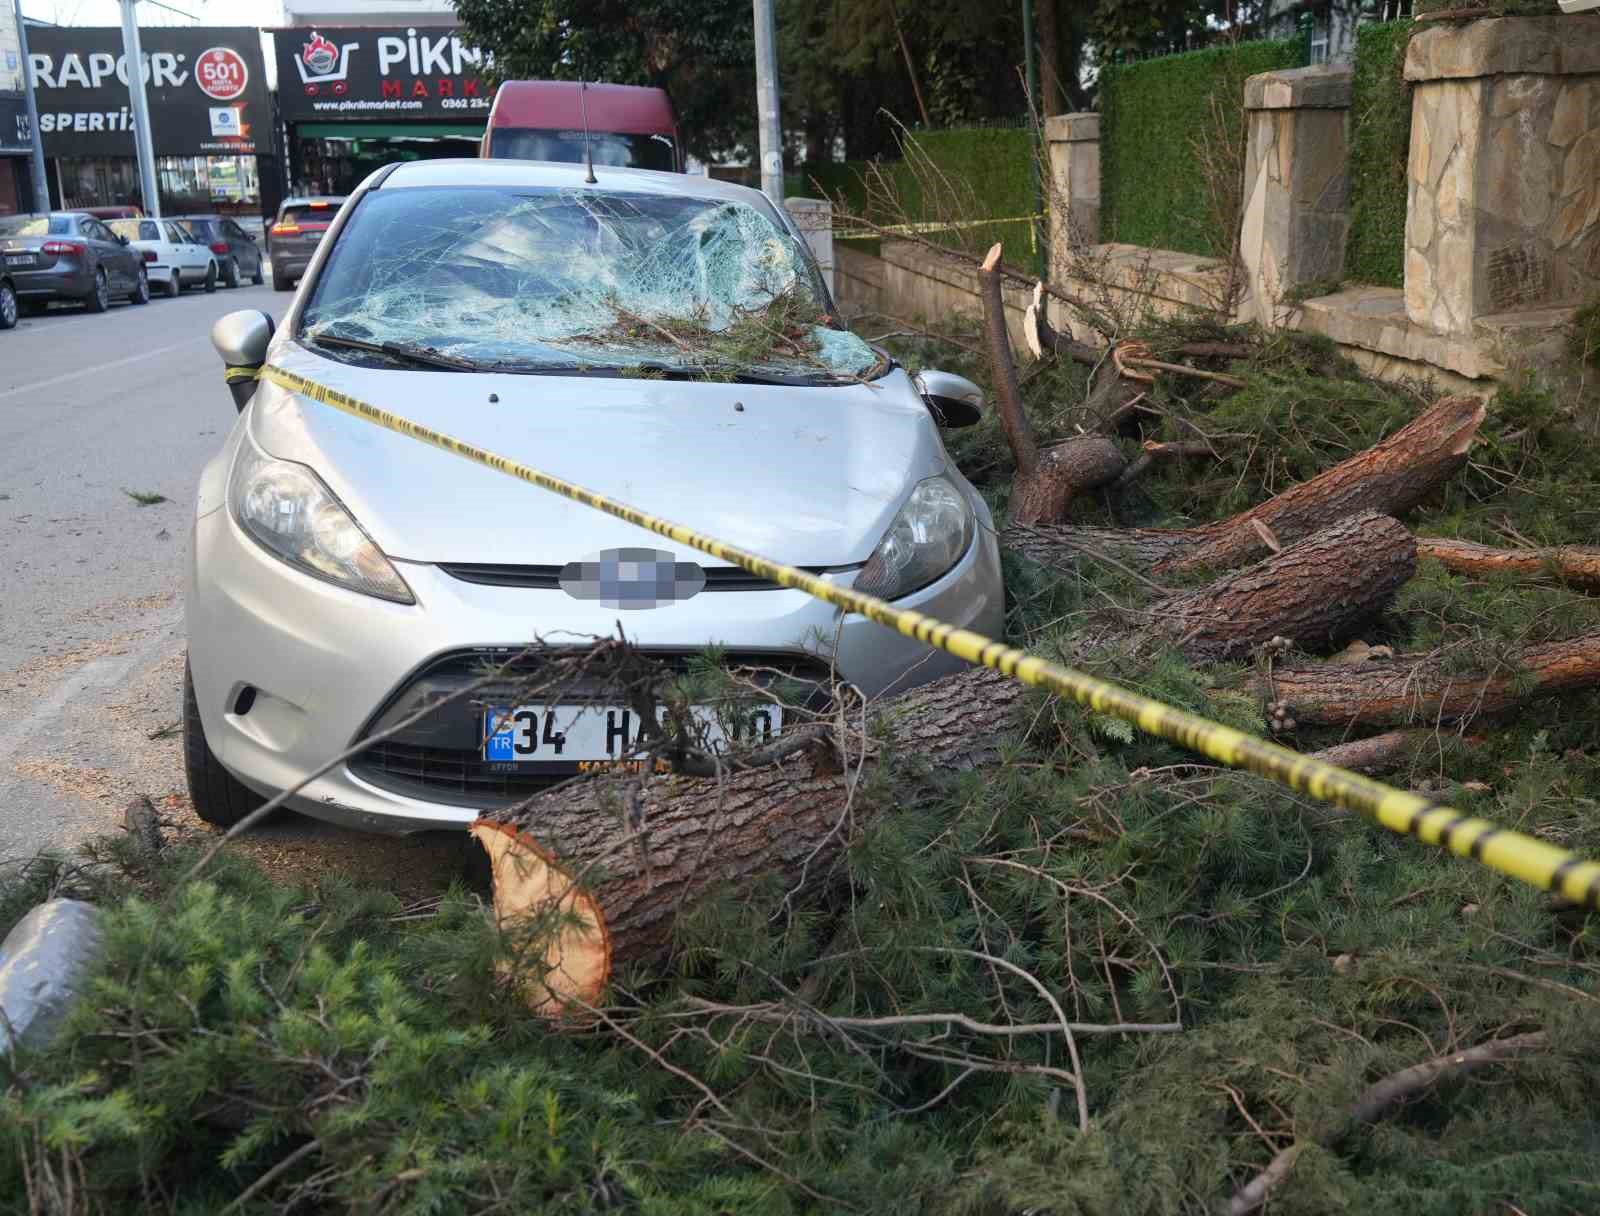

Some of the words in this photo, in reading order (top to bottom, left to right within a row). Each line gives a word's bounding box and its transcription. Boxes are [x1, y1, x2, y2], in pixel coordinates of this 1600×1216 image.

[203, 62, 239, 80] 501
[382, 79, 497, 97] MARK
[313, 100, 422, 111] www.piknikmarket.com
[441, 98, 468, 109] 0362
[514, 710, 566, 755] 34
[492, 736, 511, 750] TR
